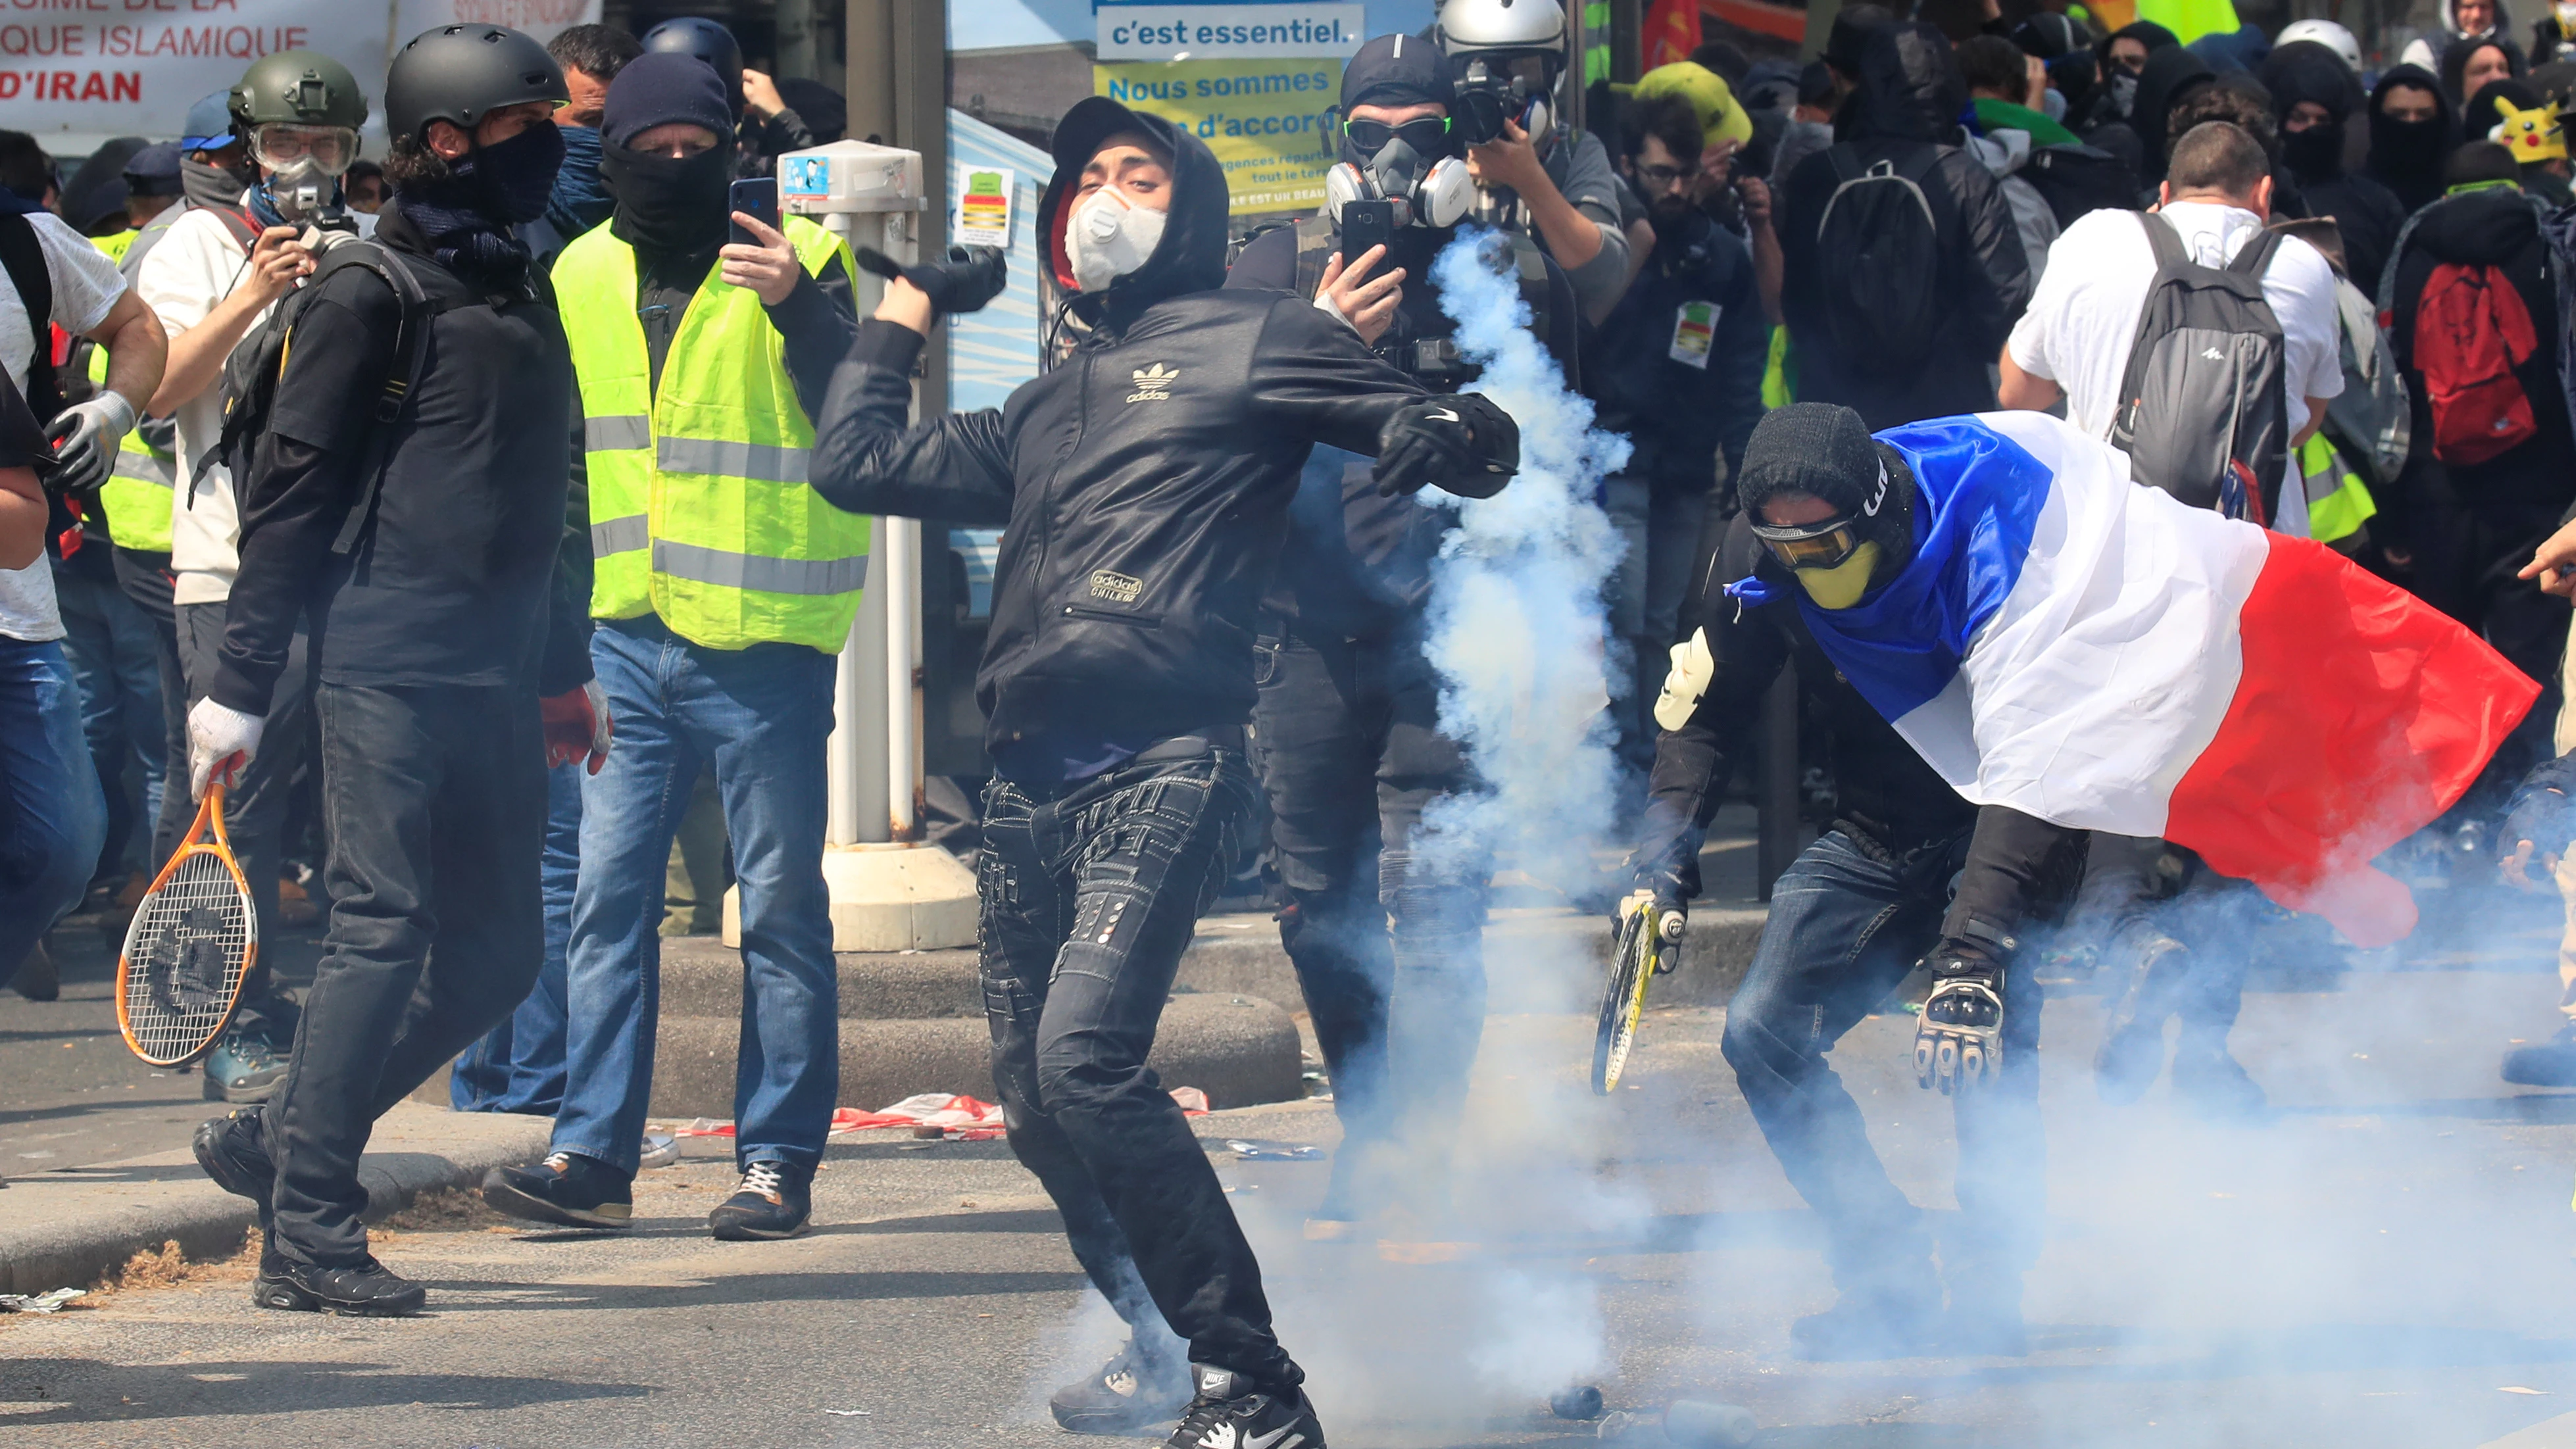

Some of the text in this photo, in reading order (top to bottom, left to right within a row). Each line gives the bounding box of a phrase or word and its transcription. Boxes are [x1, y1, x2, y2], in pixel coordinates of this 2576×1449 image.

[99, 26, 308, 58] ISLAMIQUE
[1113, 18, 1350, 44] c'est essentiel.
[0, 70, 141, 102] D'IRAN
[1109, 72, 1329, 101] Nous sommes
[1197, 112, 1335, 139] d'accord
[1252, 172, 1281, 183] tout
[1285, 170, 1297, 180] le
[1249, 193, 1272, 205] EST
[1274, 191, 1291, 202] UN
[1294, 187, 1325, 199] BEAU
[1126, 389, 1171, 403] adidas
[1093, 575, 1139, 592] adidas
[1204, 1372, 1225, 1383] NIKE
